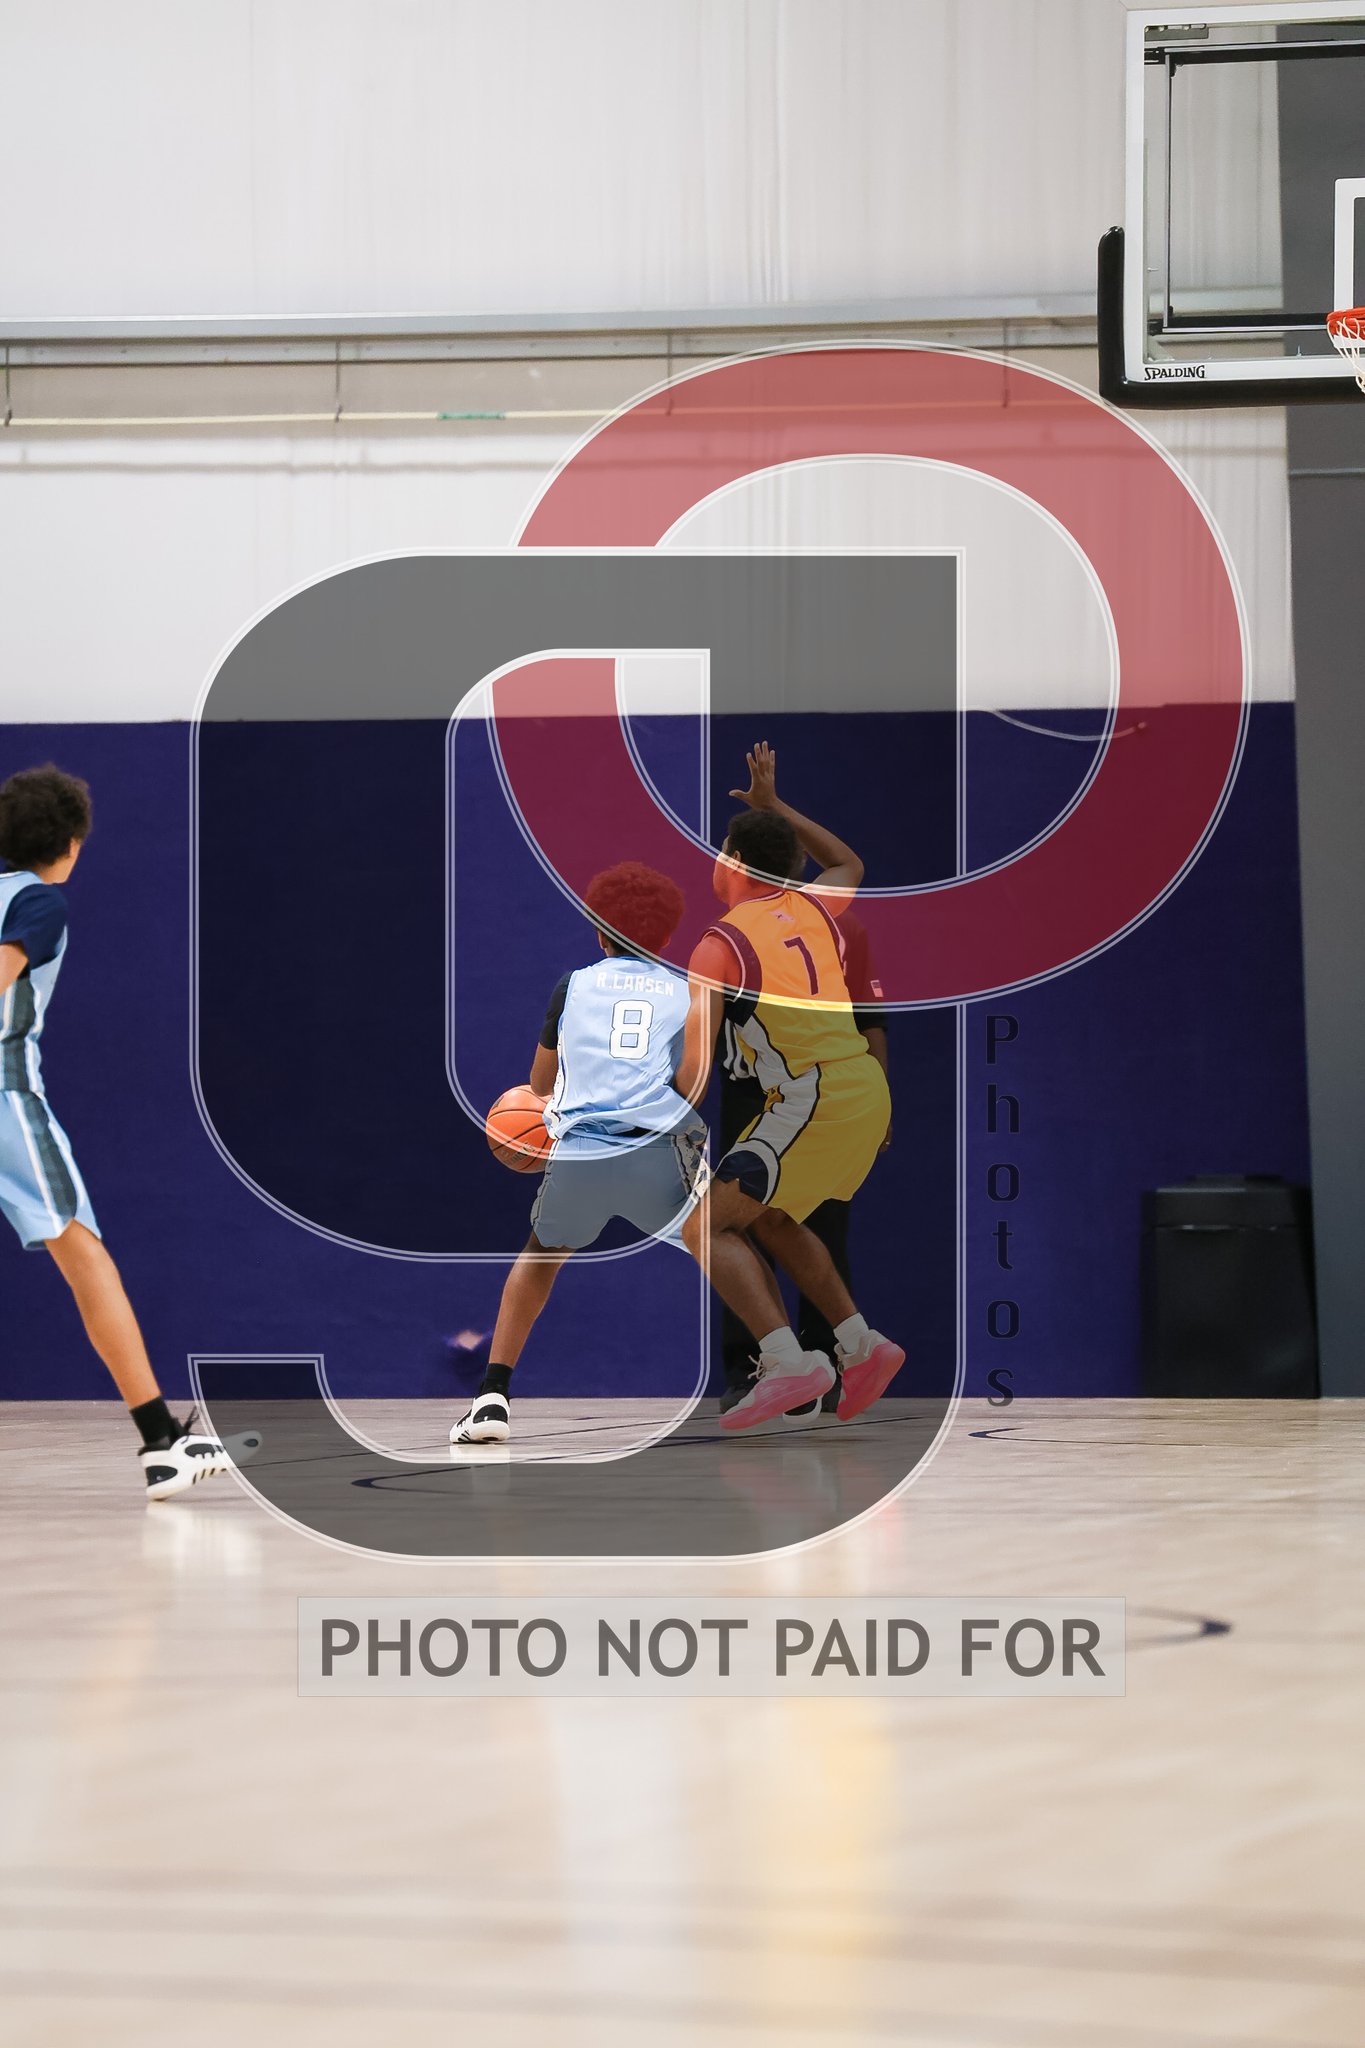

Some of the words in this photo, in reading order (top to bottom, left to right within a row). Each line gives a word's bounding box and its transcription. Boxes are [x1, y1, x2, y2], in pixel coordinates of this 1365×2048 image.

[1144, 365, 1205, 381] SPALDING
[596, 971, 674, 997] R.LARSEN
[608, 999, 655, 1060] 8
